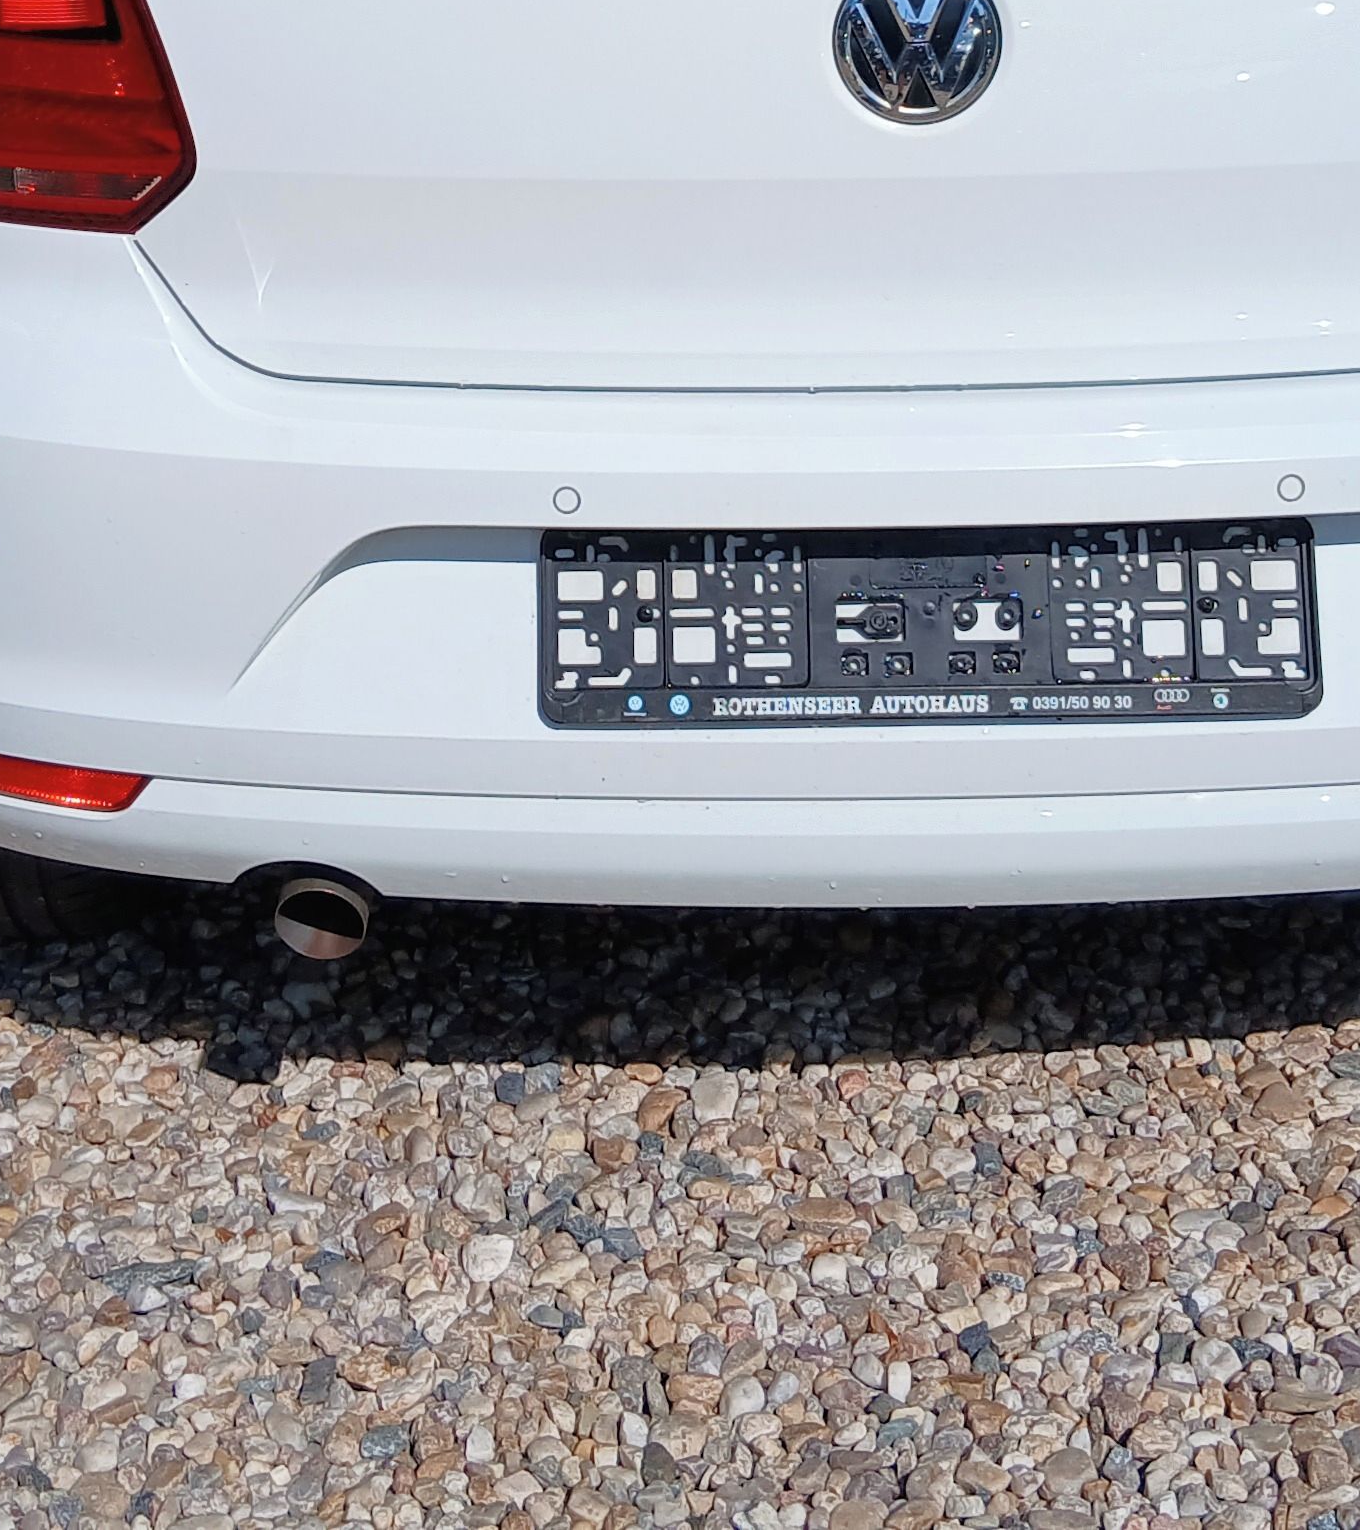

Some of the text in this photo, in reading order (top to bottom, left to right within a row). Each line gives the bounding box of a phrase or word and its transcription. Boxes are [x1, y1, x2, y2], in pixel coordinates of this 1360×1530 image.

[712, 694, 989, 716] ROTHENSEER AUTOHAUS
[1031, 695, 1132, 710] 0391/50 90 30
